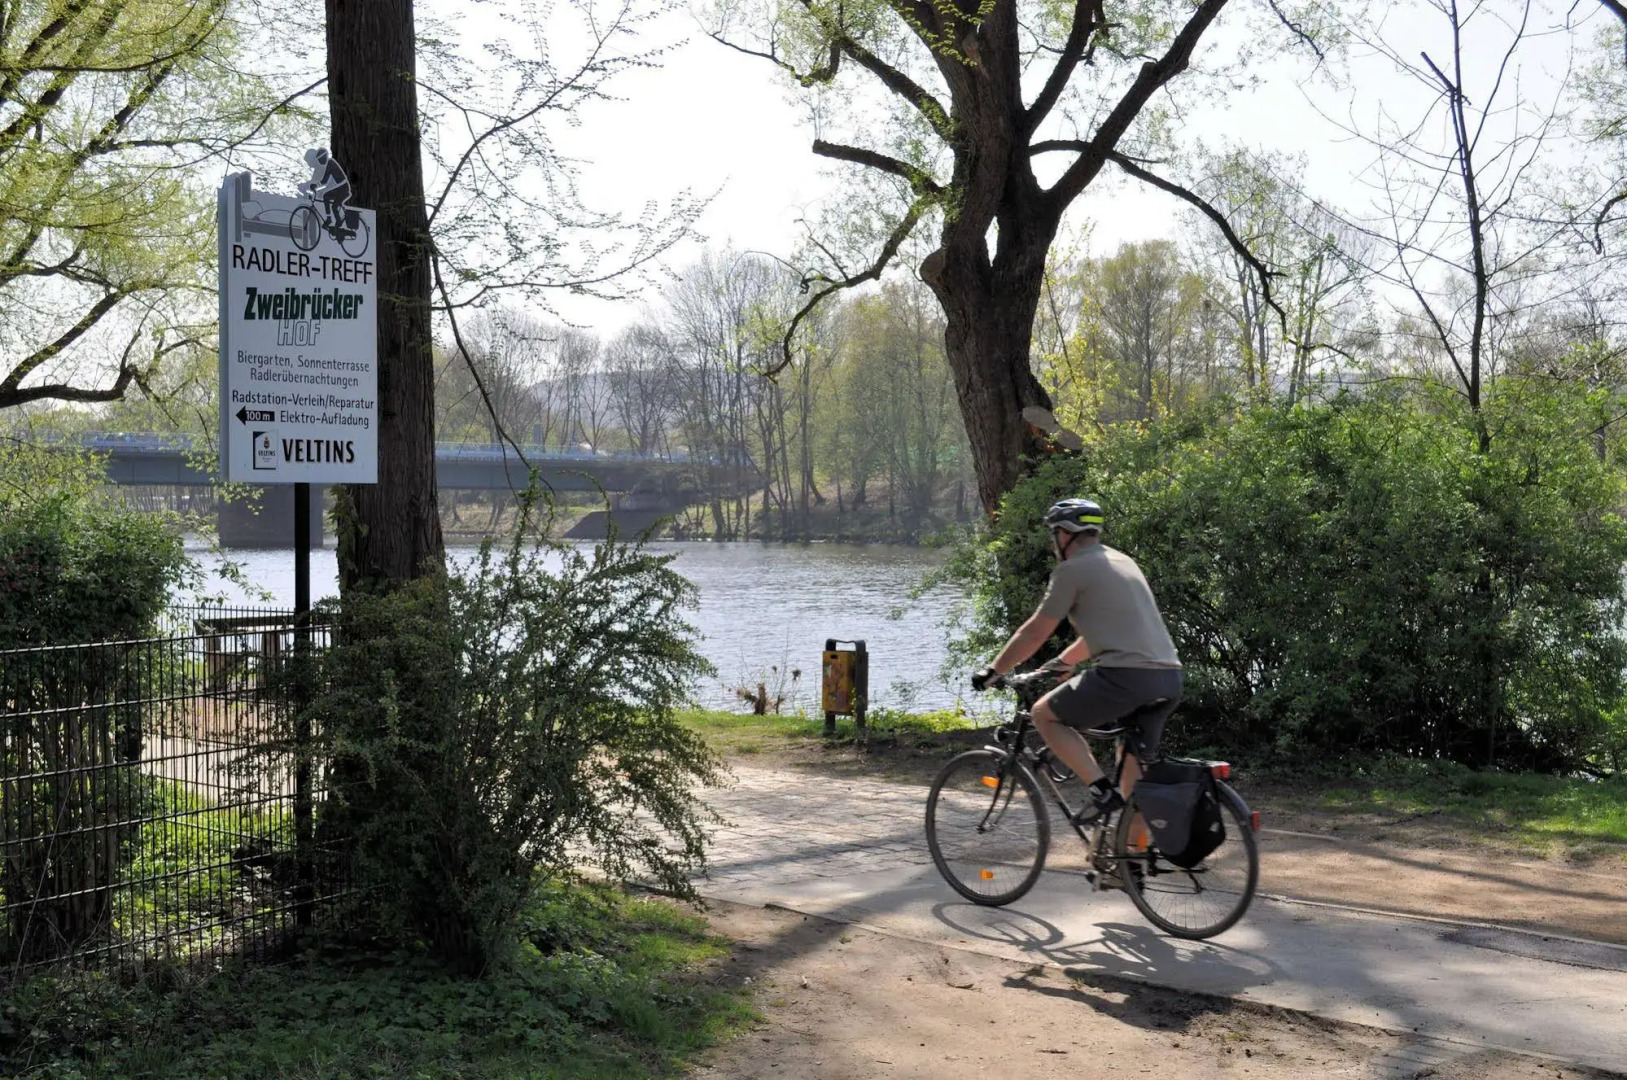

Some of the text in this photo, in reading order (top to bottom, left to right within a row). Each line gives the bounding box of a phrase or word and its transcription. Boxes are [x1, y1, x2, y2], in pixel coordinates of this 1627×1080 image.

[232, 244, 373, 285] RADLER-TREFF
[244, 287, 364, 320] Zweibrücker
[277, 318, 321, 346] HOF
[237, 350, 370, 373] Biergarten, Sonnenterrasse
[250, 368, 359, 390] Radlerübernachtungen
[232, 390, 375, 411] Radstation-Verleih/Reparatur
[246, 411, 261, 421] 100
[280, 410, 370, 429] Elektro-Aufladung
[282, 438, 355, 463] VELTINS
